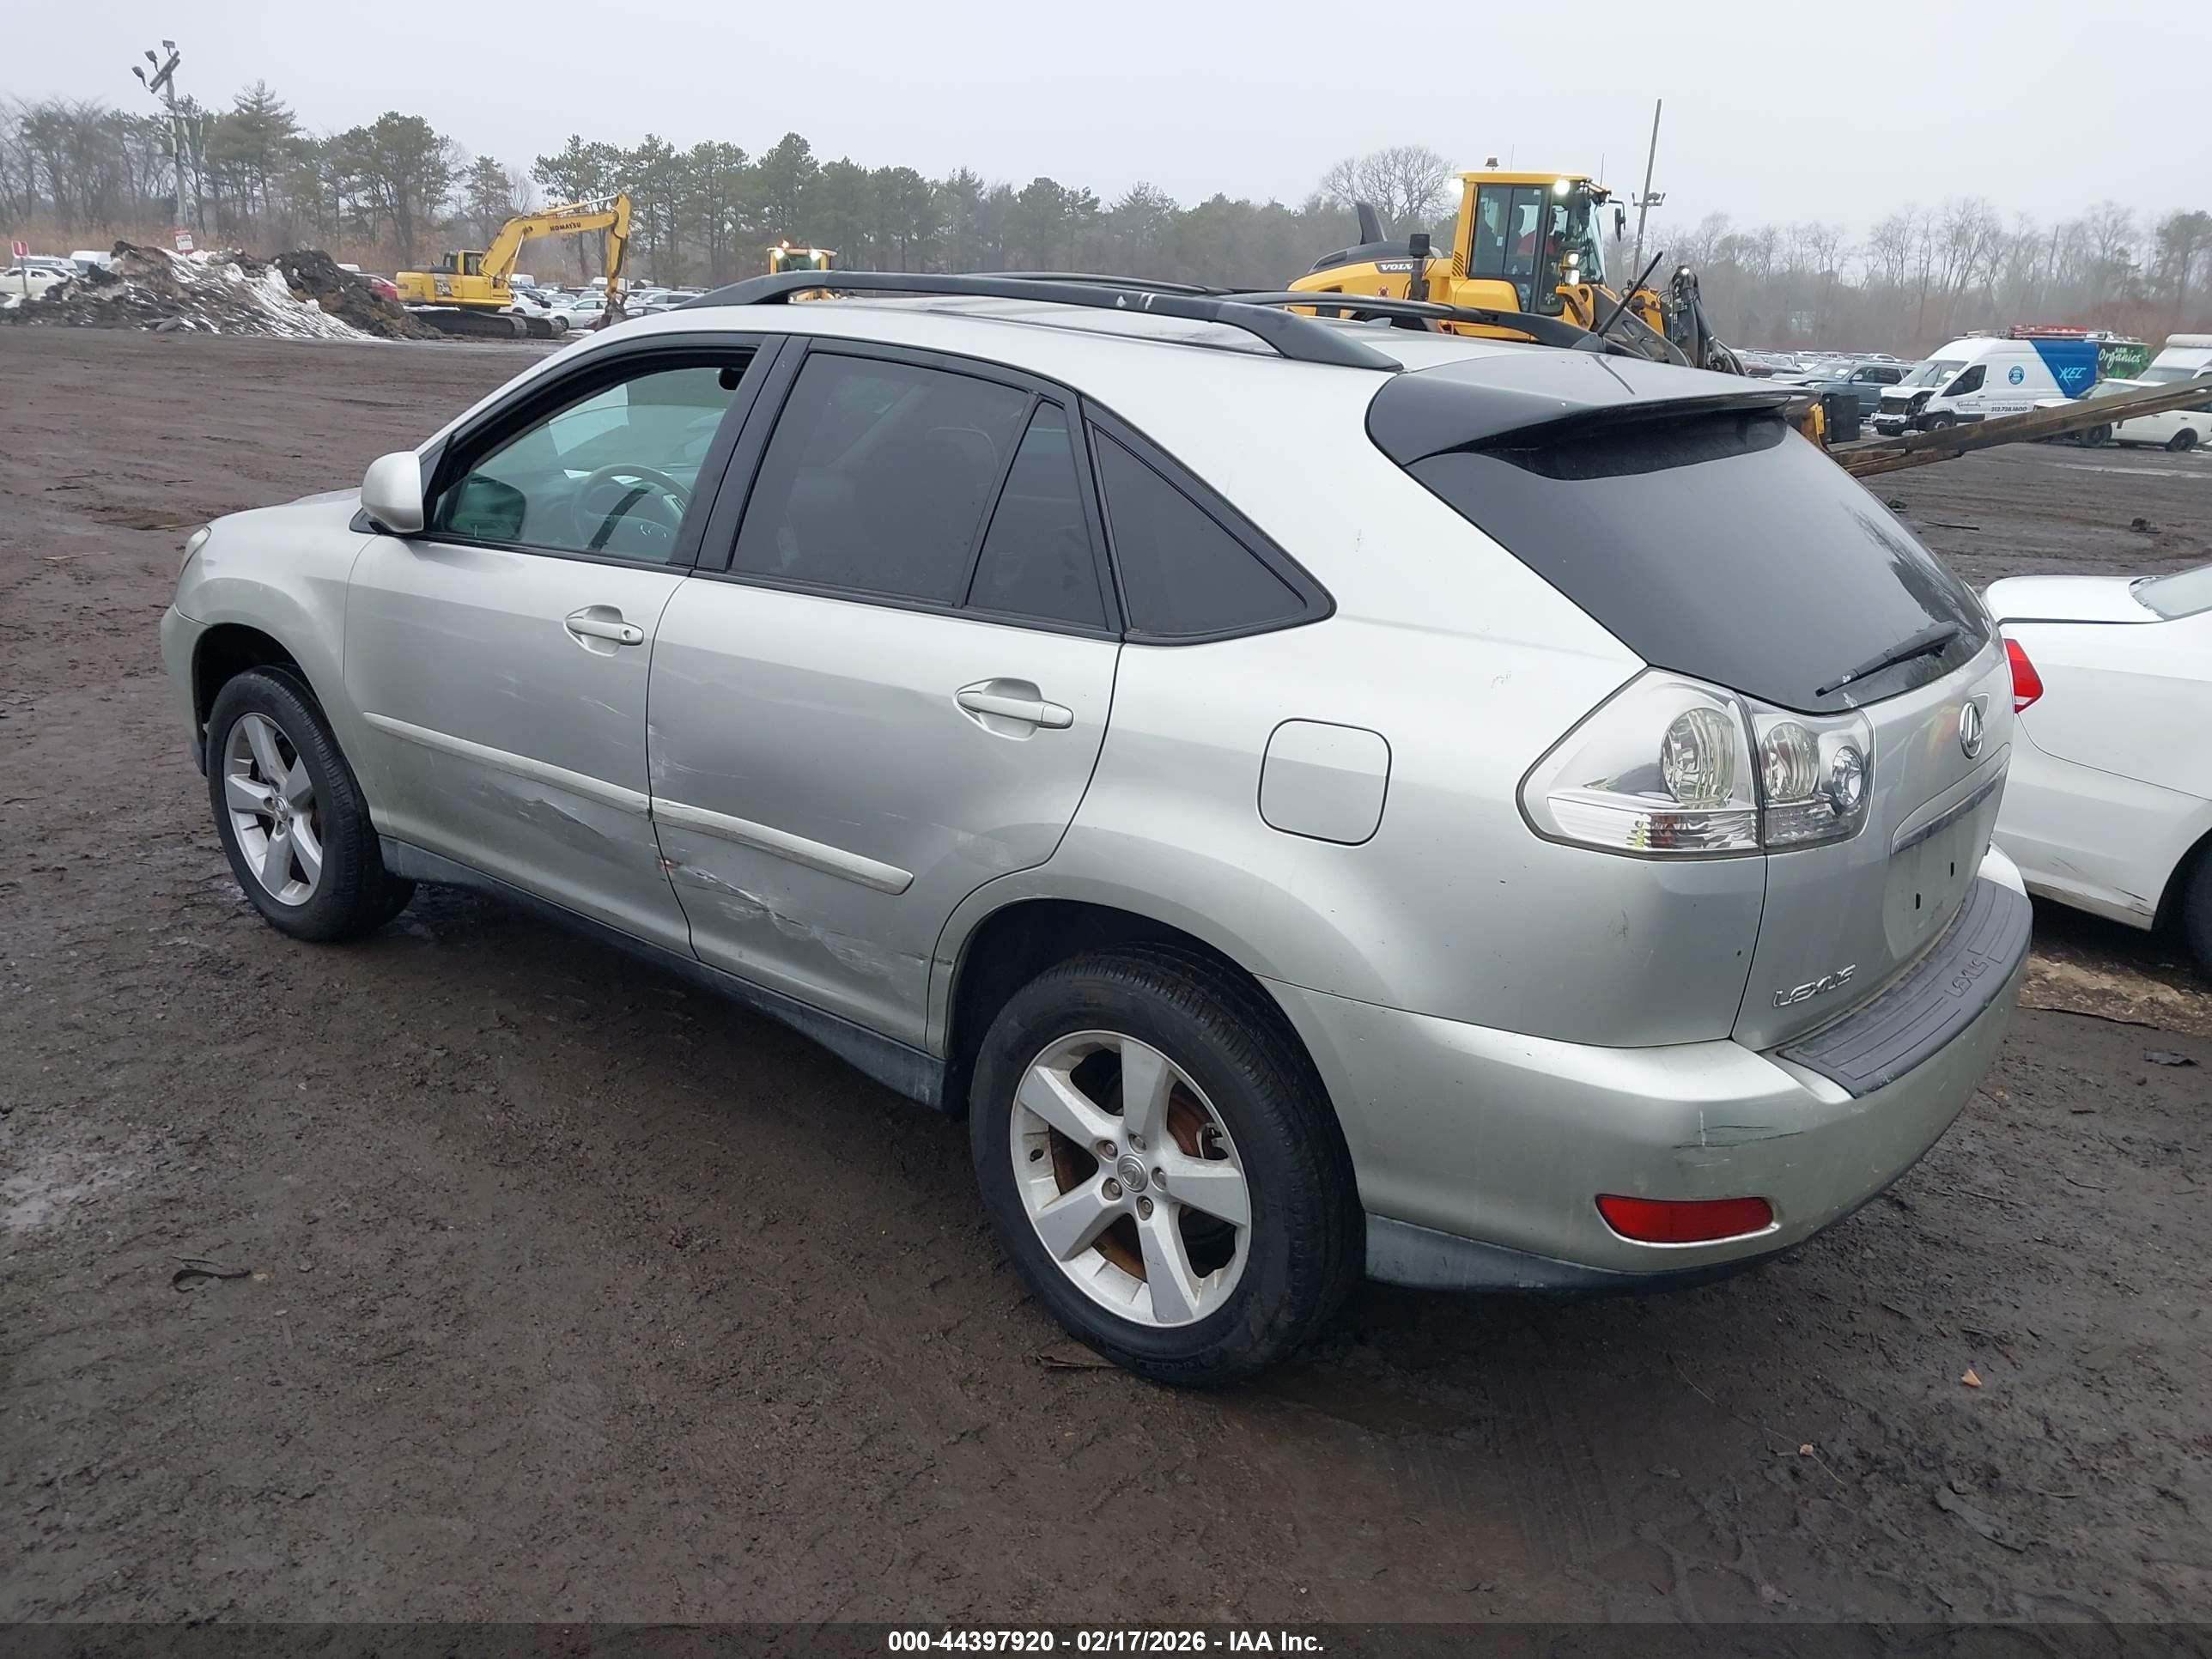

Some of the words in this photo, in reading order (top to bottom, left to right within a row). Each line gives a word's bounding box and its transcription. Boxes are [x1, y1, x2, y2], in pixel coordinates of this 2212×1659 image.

[550, 222, 581, 232] KOMATSU
[2098, 348, 2142, 370] Organics
[1771, 963, 1856, 1008] LEXUS
[1943, 957, 1990, 998] LEXUS
